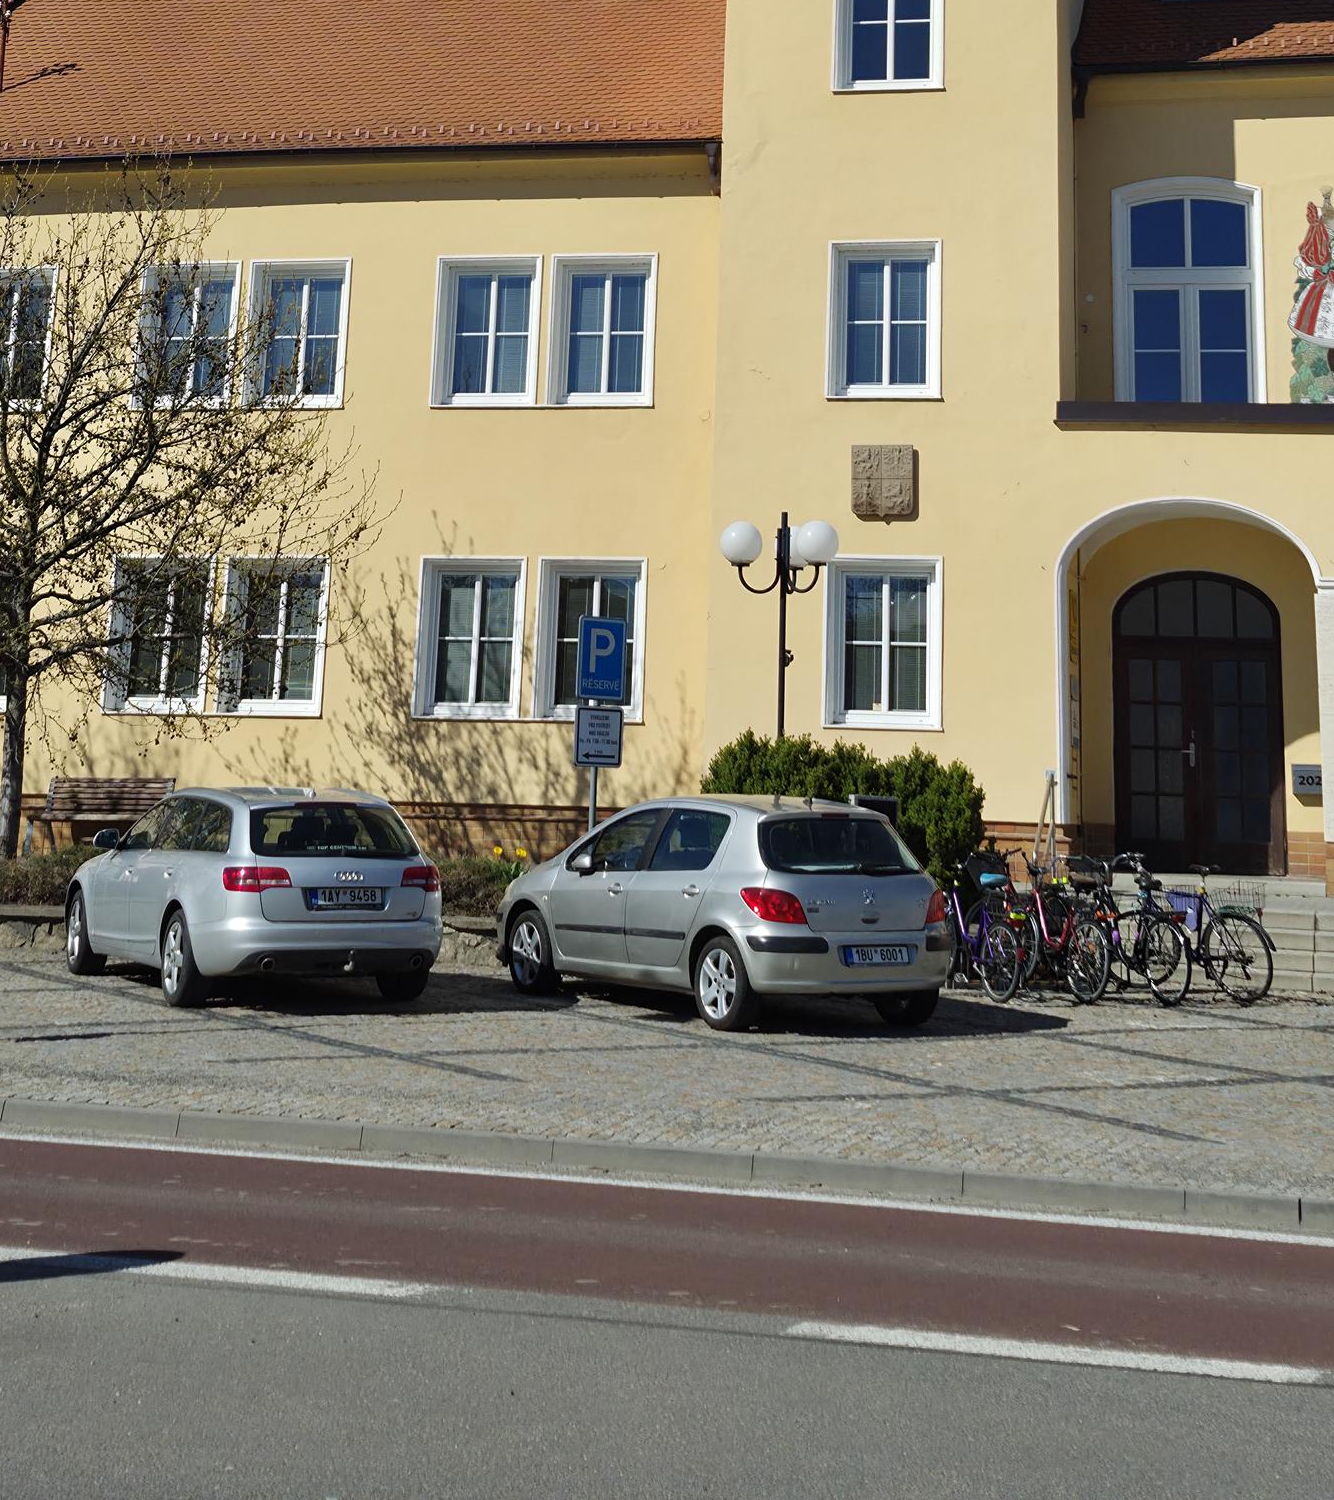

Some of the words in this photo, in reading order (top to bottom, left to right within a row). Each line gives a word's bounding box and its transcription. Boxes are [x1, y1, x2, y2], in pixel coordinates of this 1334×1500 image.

[589, 628, 616, 673] P
[1298, 775, 1322, 786] 202
[321, 889, 341, 902] 1AY
[349, 890, 377, 902] 9458
[855, 949, 873, 961] 1BU
[880, 949, 904, 961] 6001
